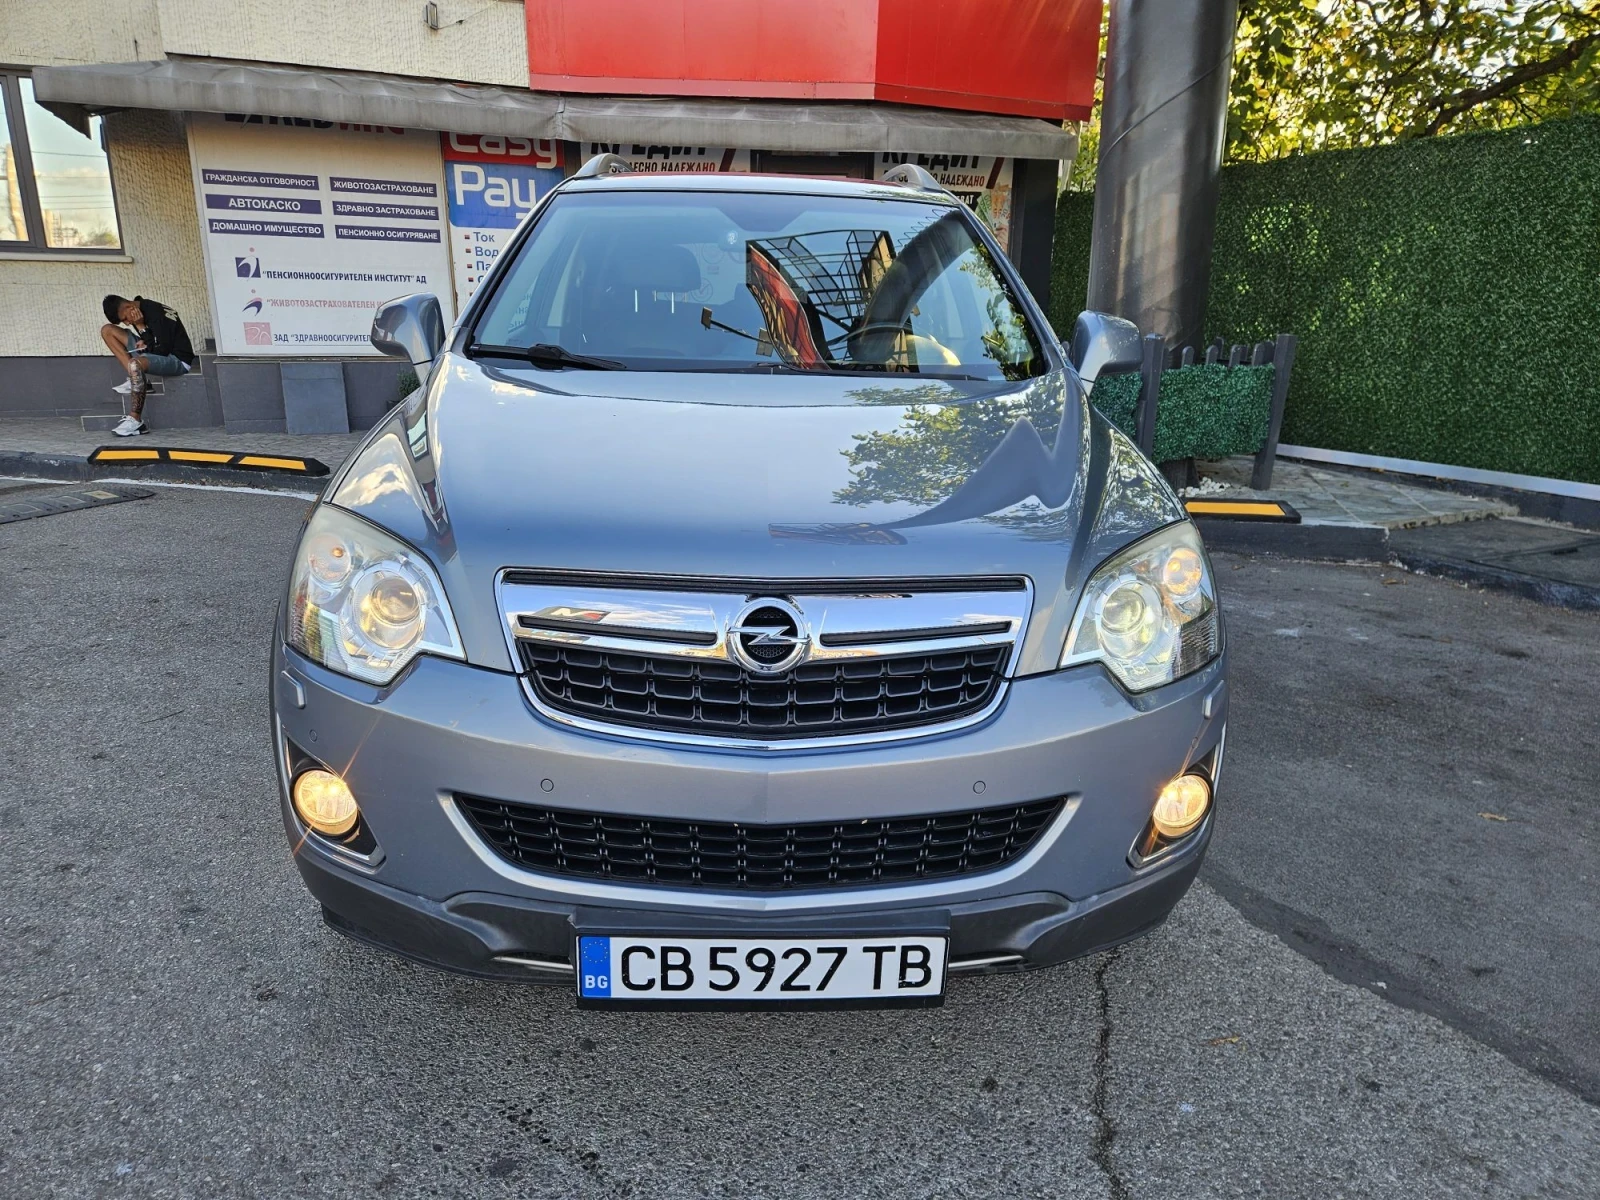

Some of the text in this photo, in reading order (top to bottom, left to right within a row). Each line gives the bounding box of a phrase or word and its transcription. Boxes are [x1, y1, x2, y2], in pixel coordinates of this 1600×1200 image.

[205, 173, 316, 187] ГРАЖДАНСКА ОТГОВОРНОСТ
[333, 180, 434, 194] ЖИВОТОЗАСТРАХОВАНЕ
[940, 173, 985, 187] НАДЕЖДНО
[453, 164, 537, 219] Pay
[228, 198, 301, 212] АВТОКАСКО
[336, 204, 436, 217] ЗДРАВНО ЗАСТРАХОВАНЕ
[212, 222, 321, 235] ДОМАШНО ИМУЩЕСТВО
[338, 228, 438, 240] ПЕНСИОННО ОСИГУРЯВАНЕ
[473, 231, 495, 242] Ток
[415, 275, 427, 285] АД
[274, 333, 289, 342] ЗАД
[708, 946, 848, 992] 5927
[584, 974, 608, 989] BG
